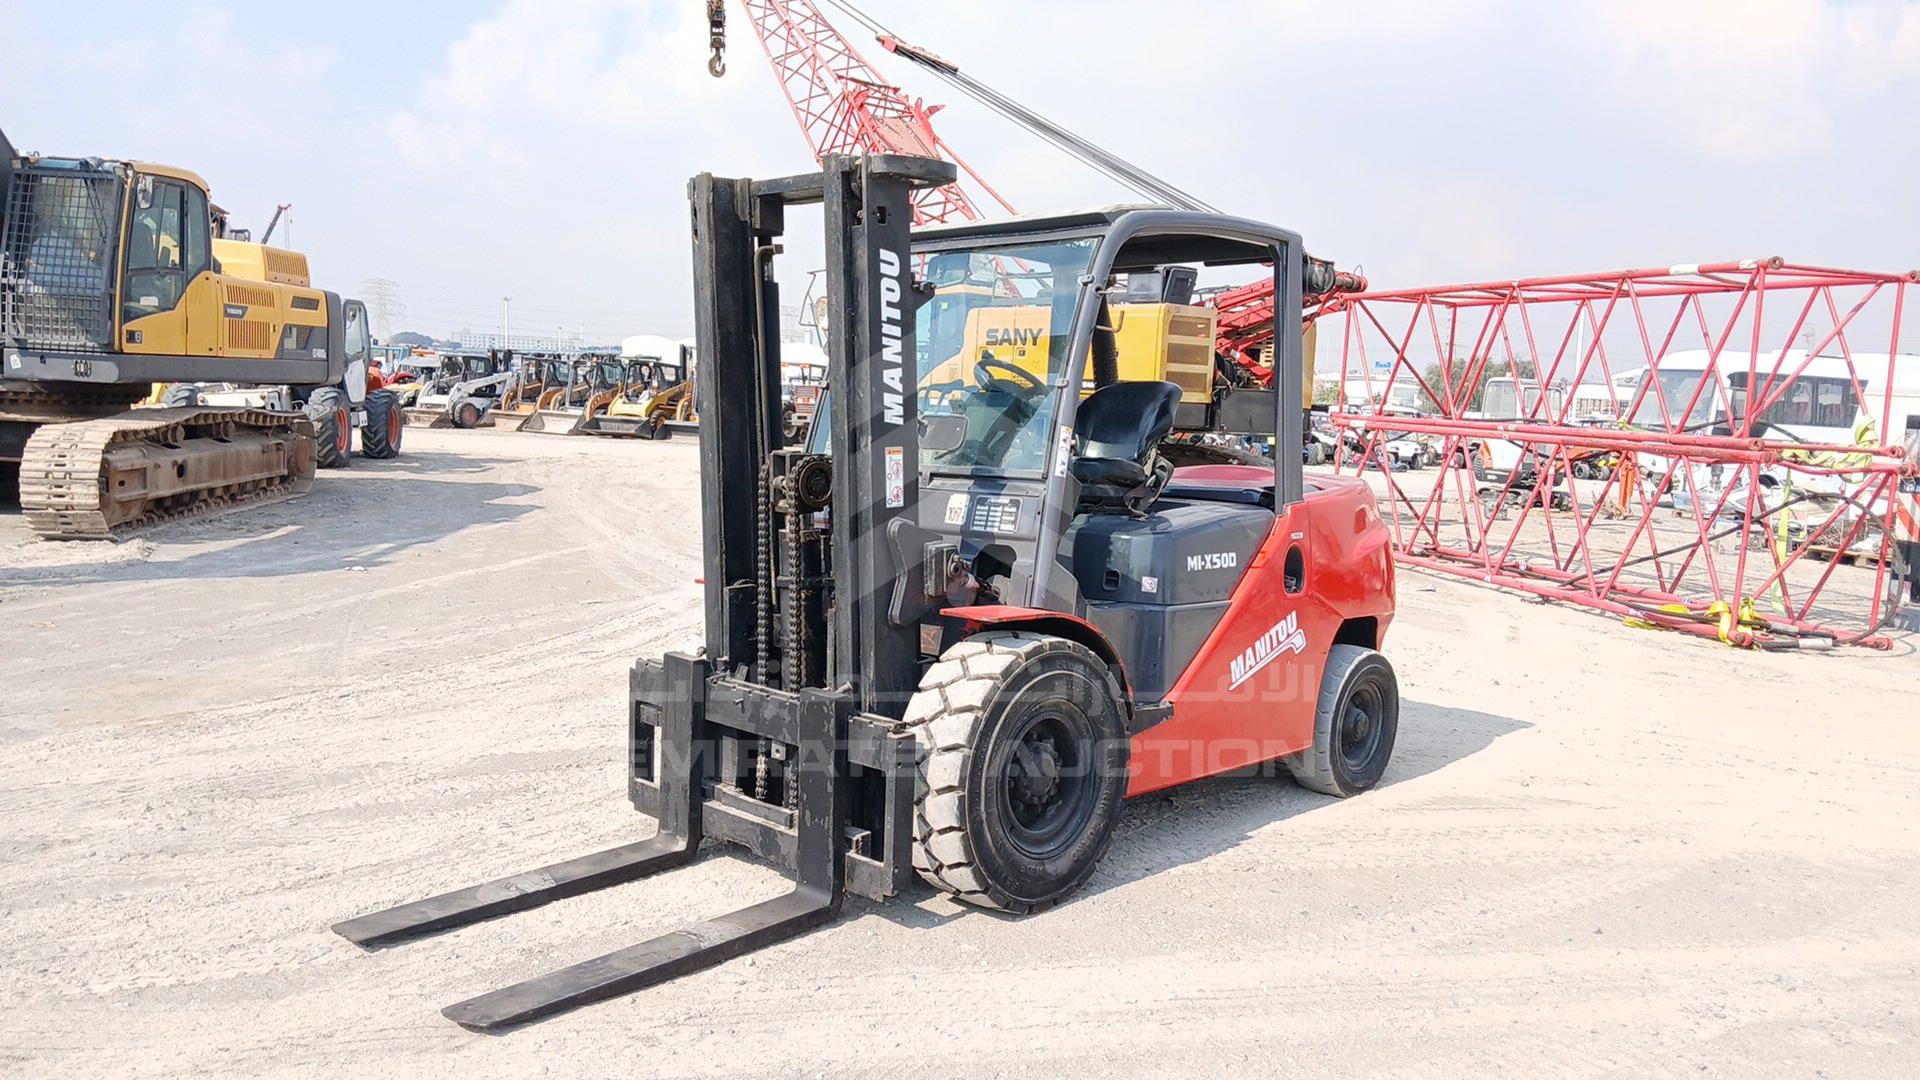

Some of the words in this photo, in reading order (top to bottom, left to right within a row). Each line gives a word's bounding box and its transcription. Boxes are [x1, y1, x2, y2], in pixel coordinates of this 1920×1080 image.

[880, 248, 905, 425] MANITOU
[985, 327, 1043, 346] SANY
[1230, 610, 1298, 684] MANITOU
